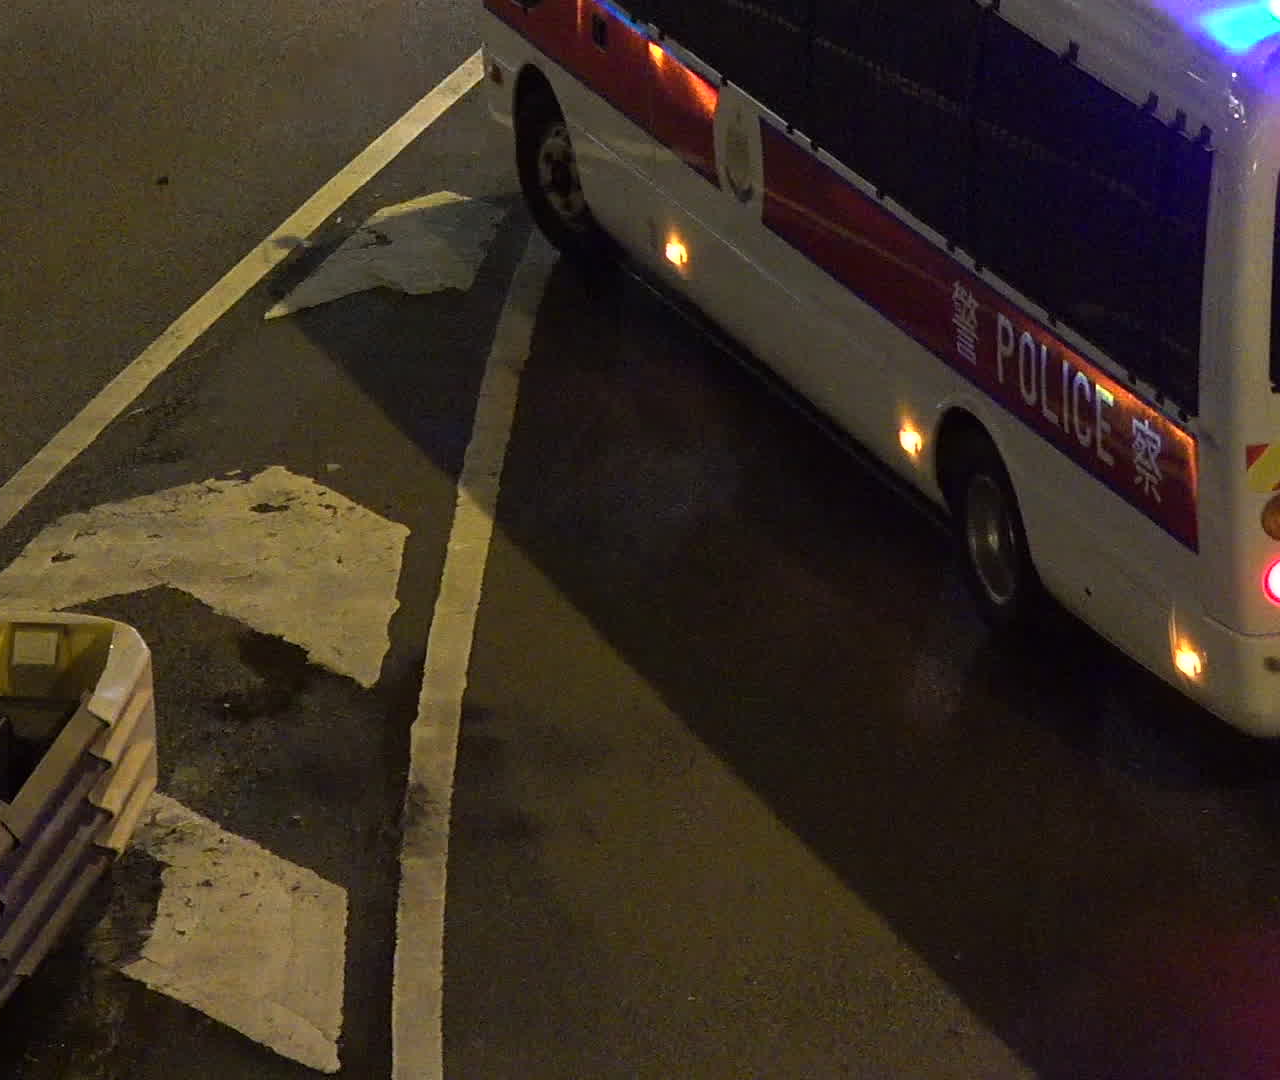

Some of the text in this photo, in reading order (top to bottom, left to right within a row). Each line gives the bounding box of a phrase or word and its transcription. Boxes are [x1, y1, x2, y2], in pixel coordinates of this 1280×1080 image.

[951, 280, 1162, 504] 警 POLICE 察
